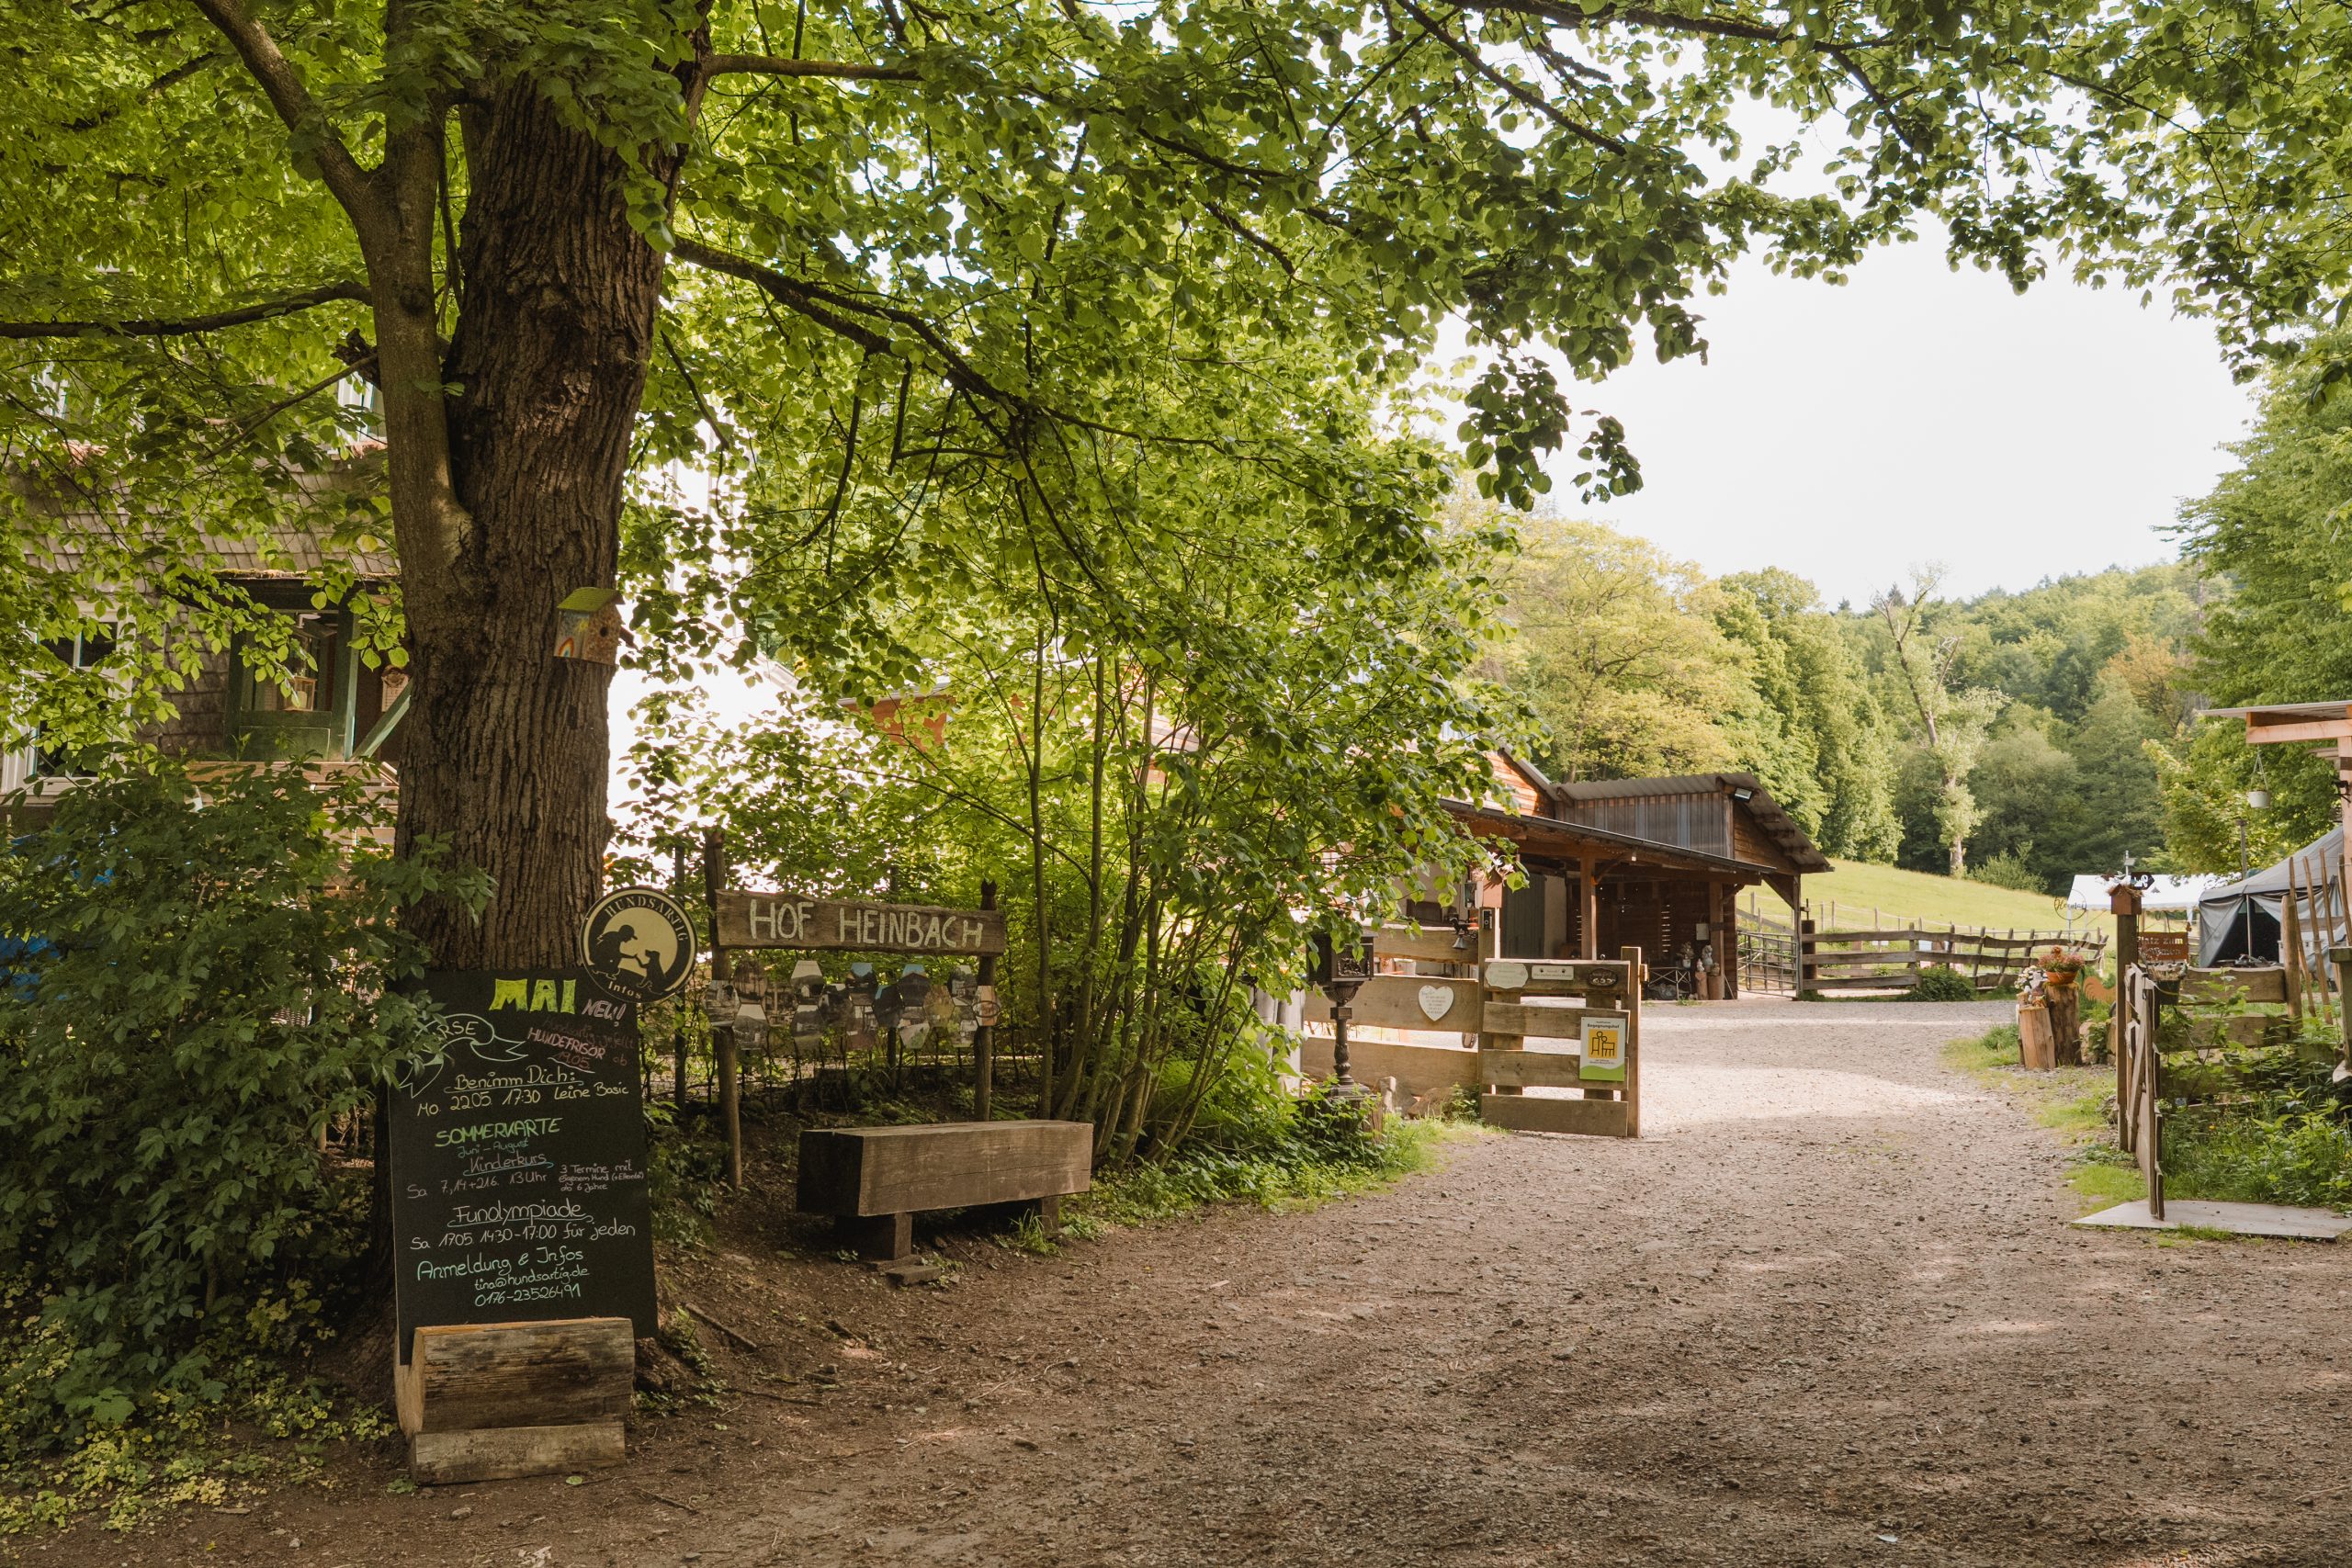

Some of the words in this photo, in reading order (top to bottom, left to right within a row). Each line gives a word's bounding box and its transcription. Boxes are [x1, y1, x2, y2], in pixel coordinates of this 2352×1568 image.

[605, 895, 688, 942] HUNDSARTIG
[750, 897, 815, 941] HOF
[838, 906, 984, 949] HEINBACH
[489, 977, 577, 1014] MAI
[608, 980, 643, 1000] Infos
[582, 998, 628, 1028] NEU!
[454, 1071, 524, 1091] Benimm
[525, 1064, 577, 1085] Dich:
[502, 1089, 541, 1106] 17:30
[554, 1085, 592, 1100] Leine
[594, 1081, 629, 1098] Basic
[435, 1117, 564, 1147] SOMMERKARTE
[457, 1144, 481, 1159] Juni
[492, 1137, 530, 1154] August
[469, 1150, 548, 1174] Kinderkurs
[560, 1164, 568, 1174] 3
[570, 1162, 610, 1175] Termine
[615, 1158, 633, 1172] mit
[576, 1182, 583, 1192] 6
[583, 1182, 609, 1193] Jahre
[591, 1173, 609, 1182] Hund
[406, 1183, 428, 1199] Sa
[410, 1236, 431, 1250] Sa
[562, 1221, 586, 1239] für
[589, 1216, 637, 1241] jeden
[416, 1251, 513, 1281] Anmeldung
[536, 1245, 584, 1267] Infos
[474, 1264, 591, 1292] tina@hundsartig.de
[474, 1282, 582, 1307] 0176-23526491
